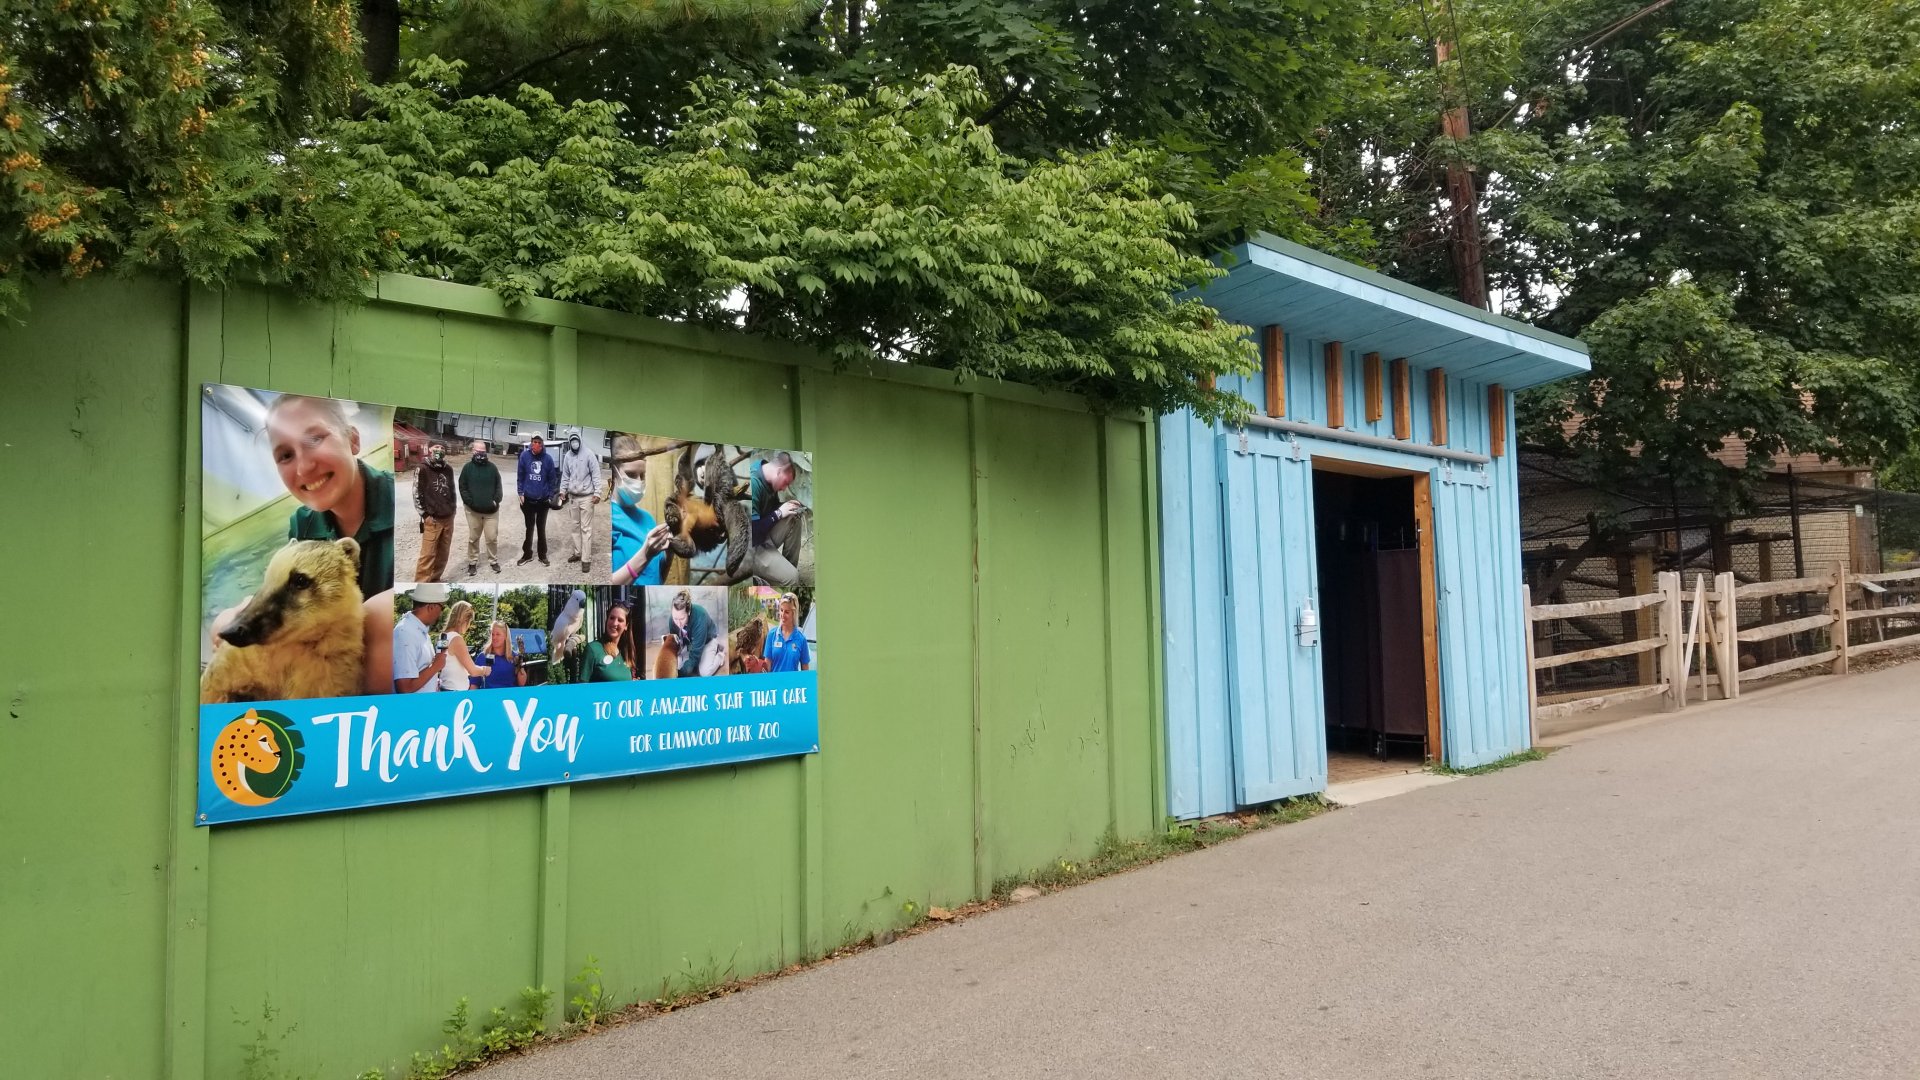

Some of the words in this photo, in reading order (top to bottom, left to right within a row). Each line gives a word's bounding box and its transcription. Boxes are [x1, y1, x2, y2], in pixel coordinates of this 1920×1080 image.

[593, 701, 611, 720] TO
[618, 699, 644, 718] OUR
[651, 694, 709, 716] AMAZING
[714, 691, 744, 711] STAFF
[749, 689, 777, 707] THAT
[783, 687, 808, 705] CARE
[312, 699, 493, 788] Thank
[503, 698, 584, 772] You
[630, 734, 653, 754] FOR
[659, 727, 721, 751] ELMWOOD
[727, 724, 753, 743] PARK
[758, 722, 780, 740] ZOO
